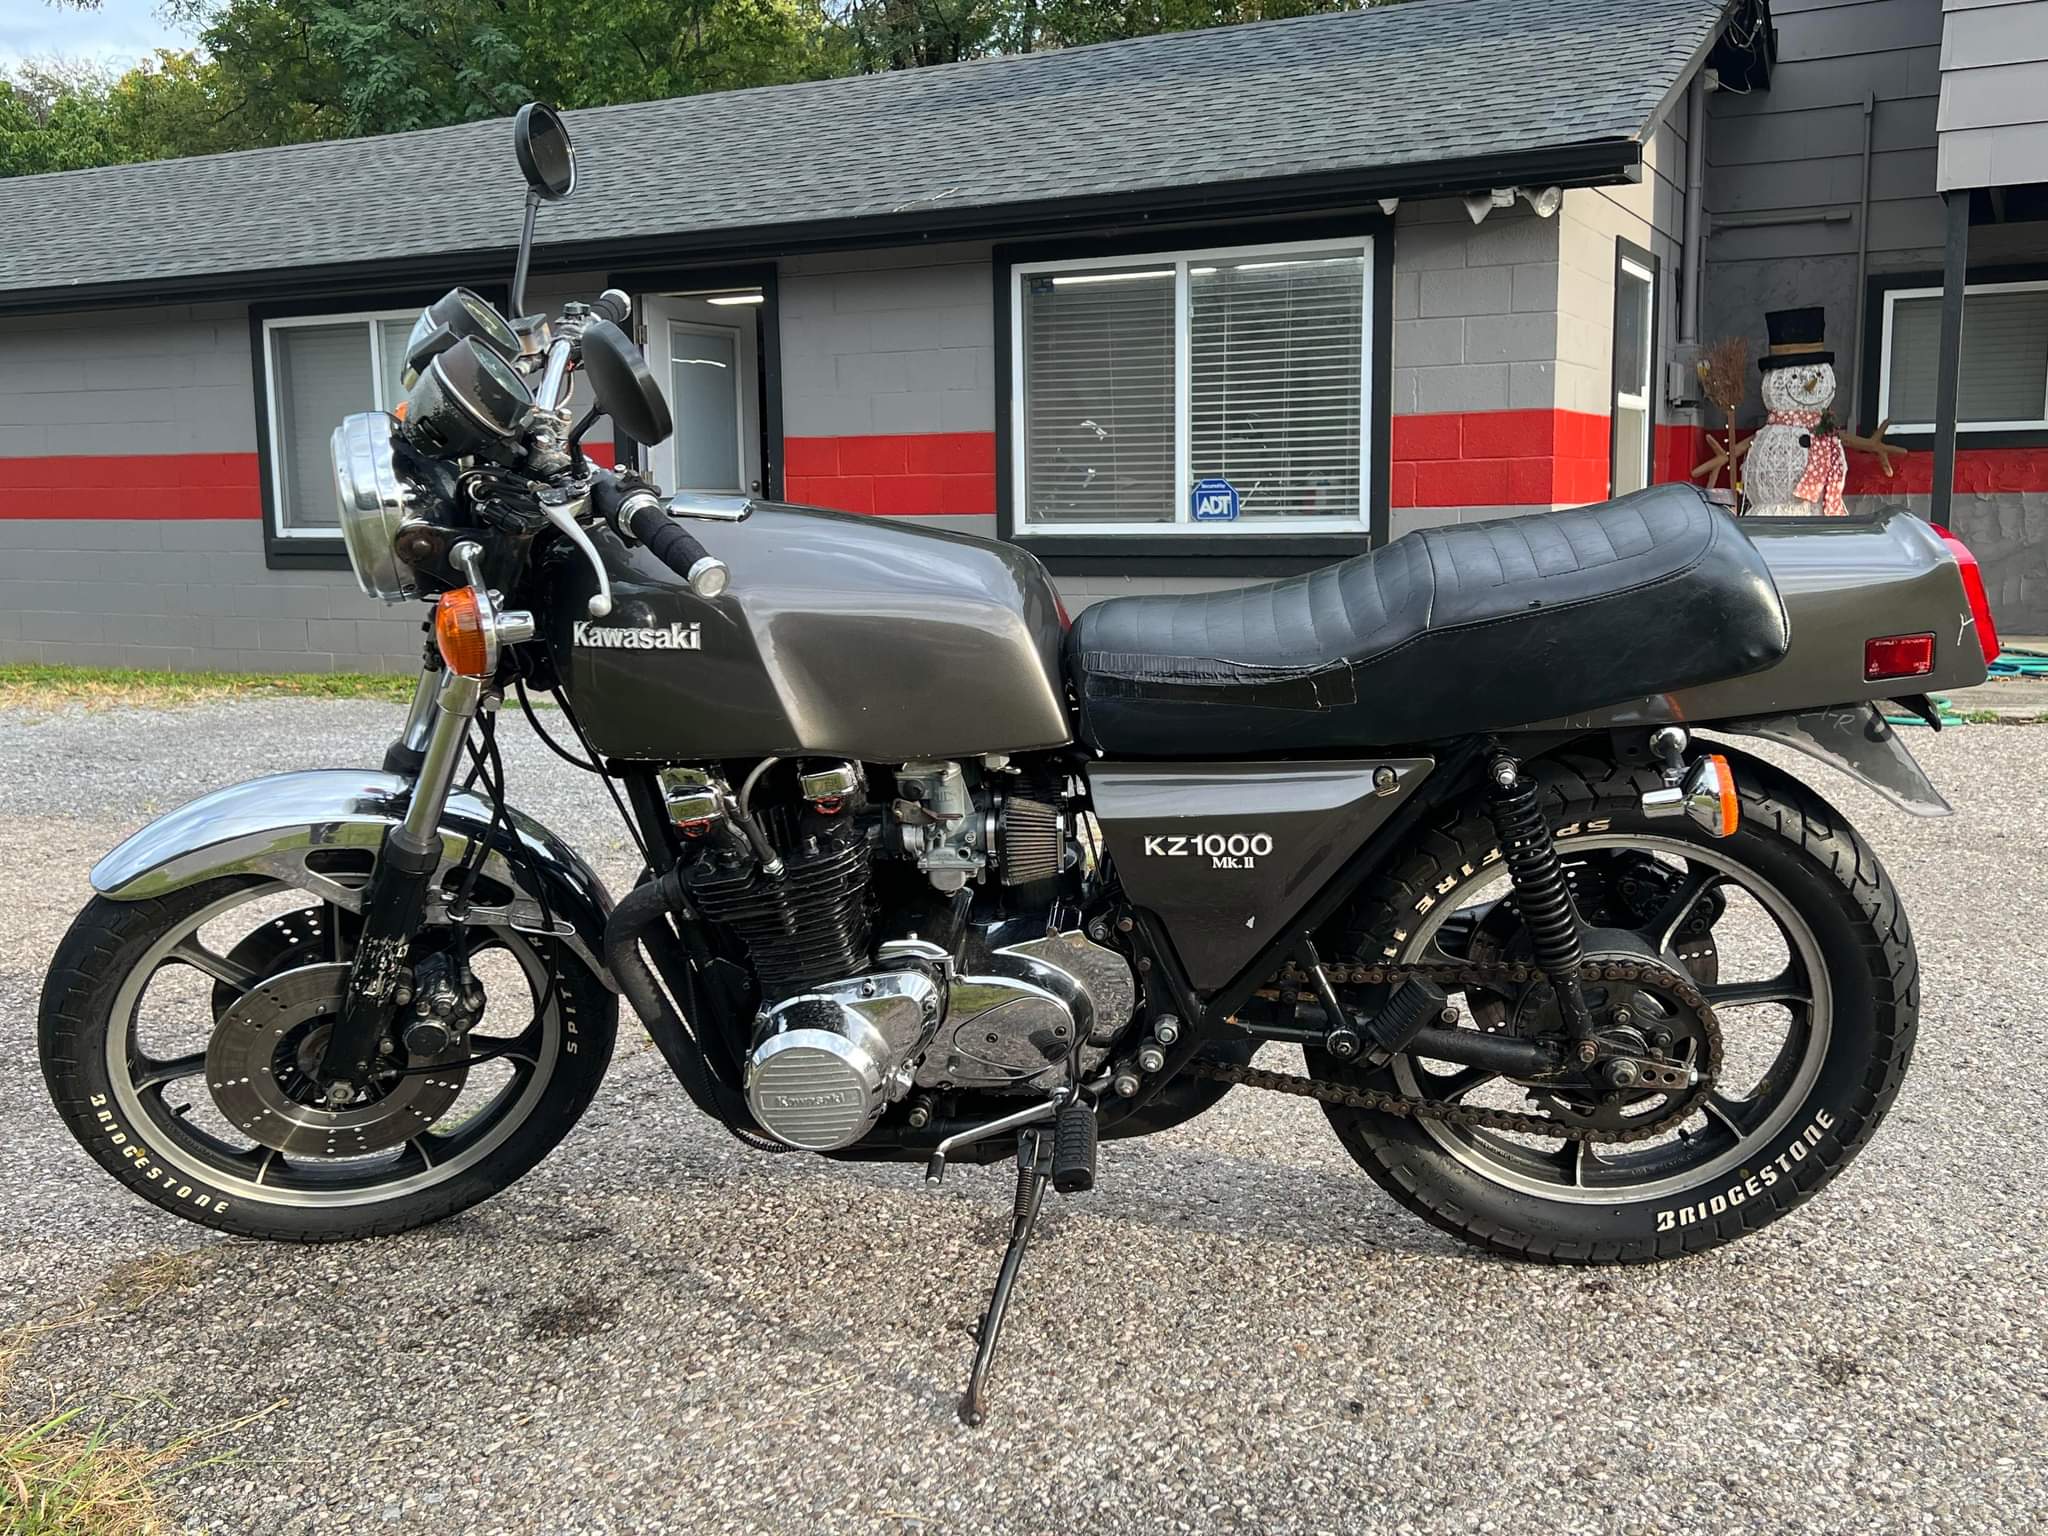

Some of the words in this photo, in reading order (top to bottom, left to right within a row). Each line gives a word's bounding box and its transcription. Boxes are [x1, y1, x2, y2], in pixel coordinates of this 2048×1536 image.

[1199, 495, 1231, 515] ADT
[573, 620, 701, 650] Kawasaki
[1144, 833, 1273, 856] KZ1000
[90, 1093, 230, 1214] BRIDGESTONE
[1656, 1107, 1836, 1232] BRIDGESTONE
